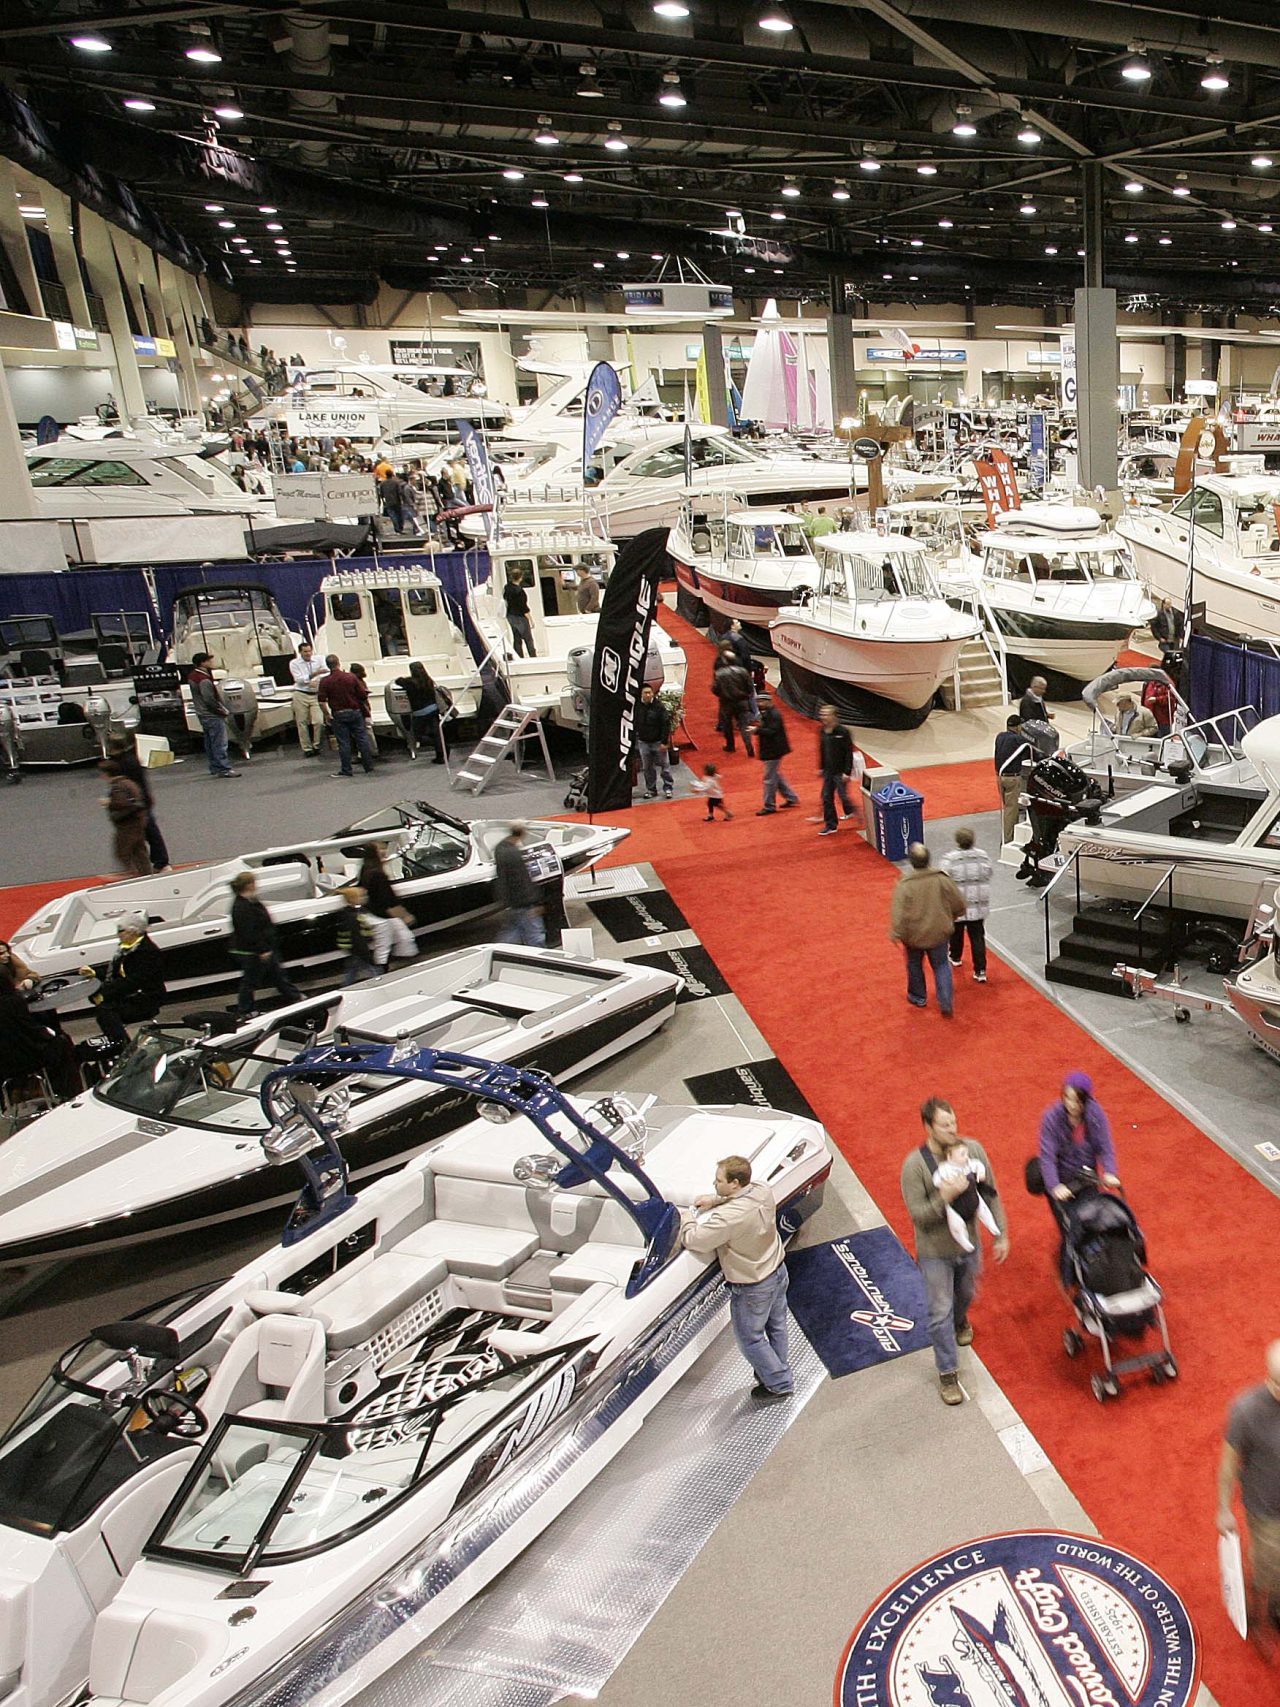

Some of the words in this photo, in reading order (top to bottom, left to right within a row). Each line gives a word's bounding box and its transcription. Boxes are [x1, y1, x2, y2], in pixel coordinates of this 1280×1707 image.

[1065, 377, 1077, 402] G
[299, 413, 327, 421] LAKE
[331, 413, 366, 421] UNION
[327, 488, 374, 500] Campion
[982, 475, 1003, 528] WHA
[781, 634, 801, 650] TROPHY
[619, 574, 651, 772] NAUTIQUE
[1034, 774, 1067, 799] MERCURY
[872, 1329, 897, 1351] AIR
[1056, 1543, 1113, 1570] WORLD
[1117, 1562, 1146, 1587] THE
[866, 1550, 986, 1651] EXCELLENCE
[1015, 1567, 1069, 1635] Craft
[1137, 1584, 1159, 1602] OF
[1080, 1591, 1124, 1657] ESTABLISHED
[1155, 1601, 1181, 1655] WATERS
[1164, 1656, 1182, 1686] THE
